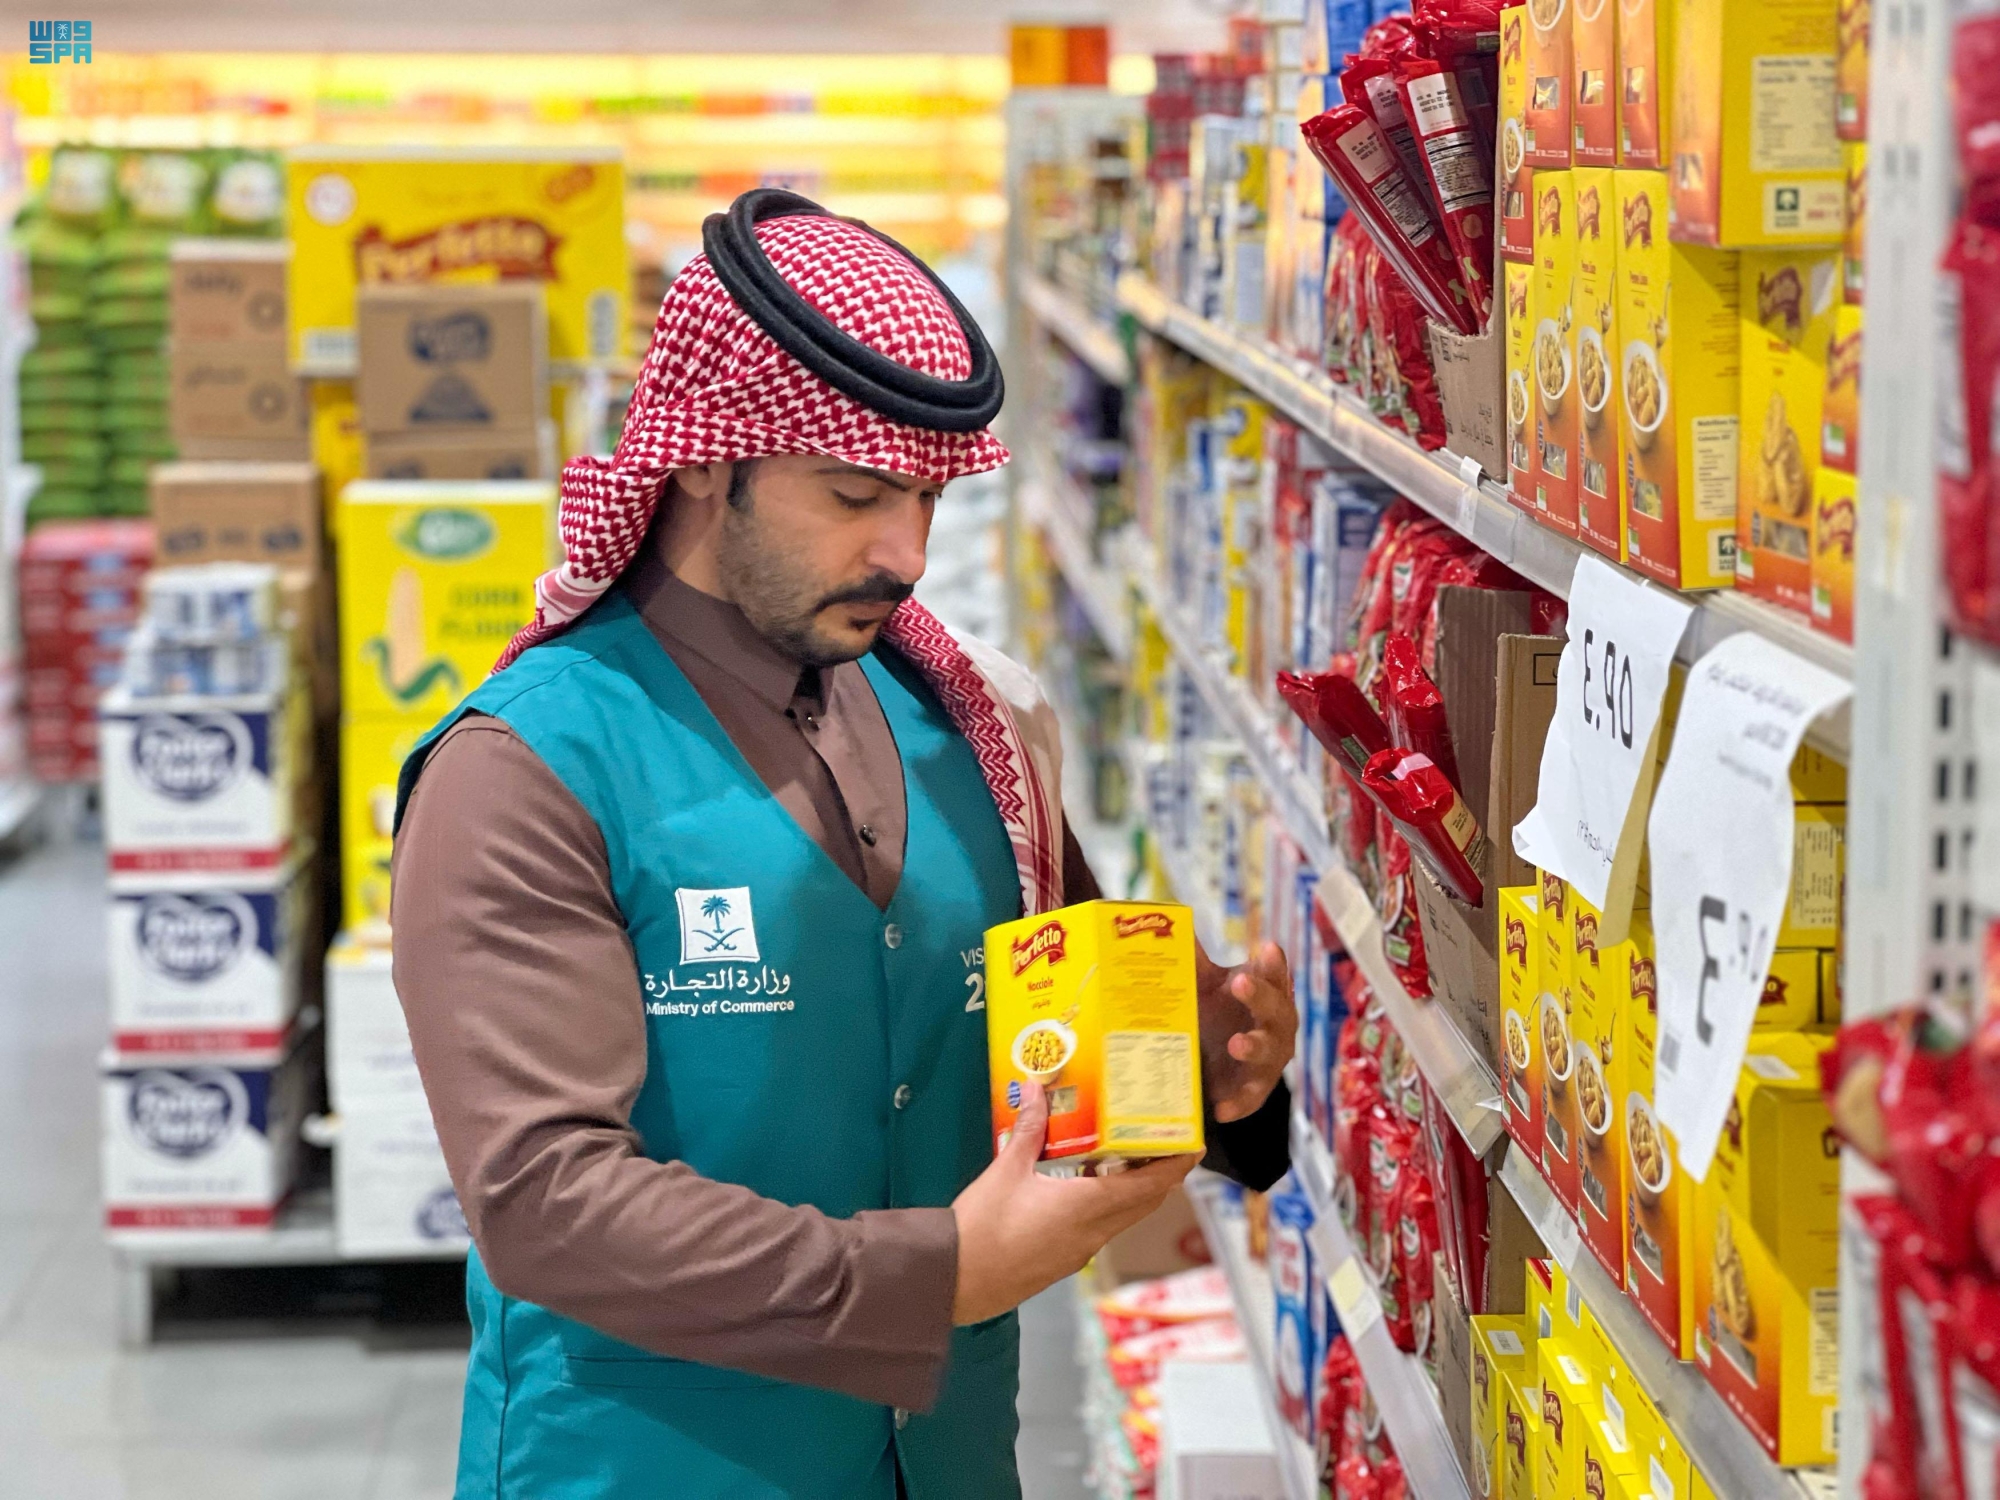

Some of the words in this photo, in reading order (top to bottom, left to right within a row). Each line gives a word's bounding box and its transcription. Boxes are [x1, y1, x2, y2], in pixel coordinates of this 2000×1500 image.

[960, 947, 984, 968] VIS
[1013, 927, 1061, 972] Perfetto
[644, 966, 734, 998] التجارة
[737, 964, 791, 995] وزارة
[646, 1000, 699, 1017] Ministry
[701, 1000, 718, 1014] of
[720, 998, 796, 1014] Commerce
